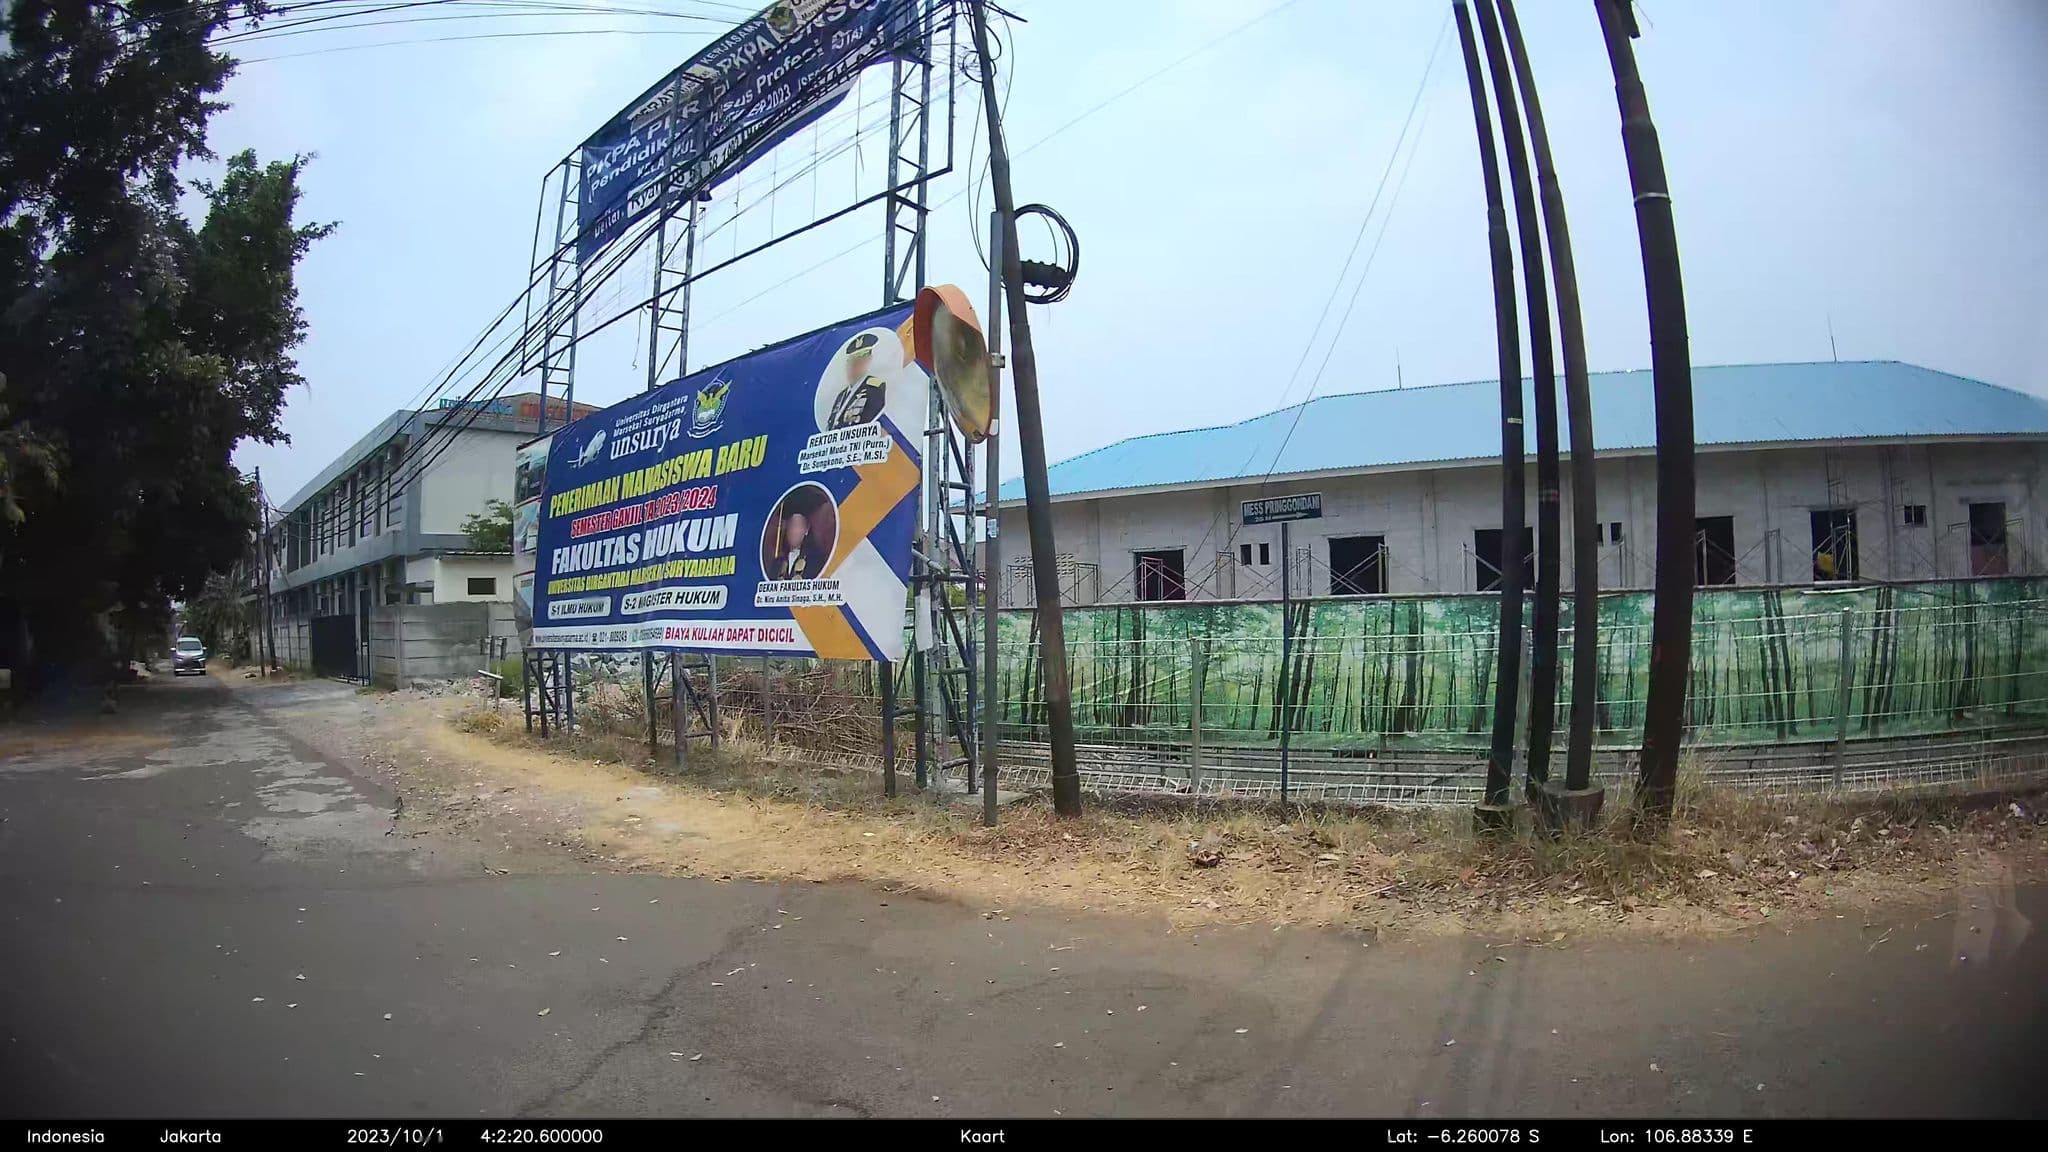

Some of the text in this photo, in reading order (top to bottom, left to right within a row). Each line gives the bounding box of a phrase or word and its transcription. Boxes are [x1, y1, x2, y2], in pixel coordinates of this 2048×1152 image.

[615, 407, 650, 428] Universitas
[651, 395, 689, 415] Dirgantara
[610, 418, 681, 460] unsurya
[613, 419, 643, 438] Marsekal
[809, 425, 878, 449] REKTOR UNSURYA
[800, 439, 890, 460] Marsekal Muda TNI (Purn.)
[549, 434, 768, 518] PENERIMAAN MAHASISWA BARU
[571, 509, 612, 539] SEMESTER
[612, 500, 643, 531] GANJIL
[551, 513, 739, 575] FAKULTAS HUKUM
[547, 576, 586, 595] UNIVERSITAS
[585, 568, 631, 591] DIRGANTARA
[663, 555, 736, 580] SURYADARMA
[758, 580, 840, 593] DEKAN FAKULTAS HUKUM
[560, 603, 578, 616] ILMU
[578, 601, 605, 614] HUKUM
[624, 590, 721, 610] S-2 MAGISTER HUKUM
[665, 626, 690, 640] BIAYA
[692, 627, 725, 642] KULIAH
[726, 628, 755, 643] DAPAT
[757, 628, 795, 643] DICICIL
